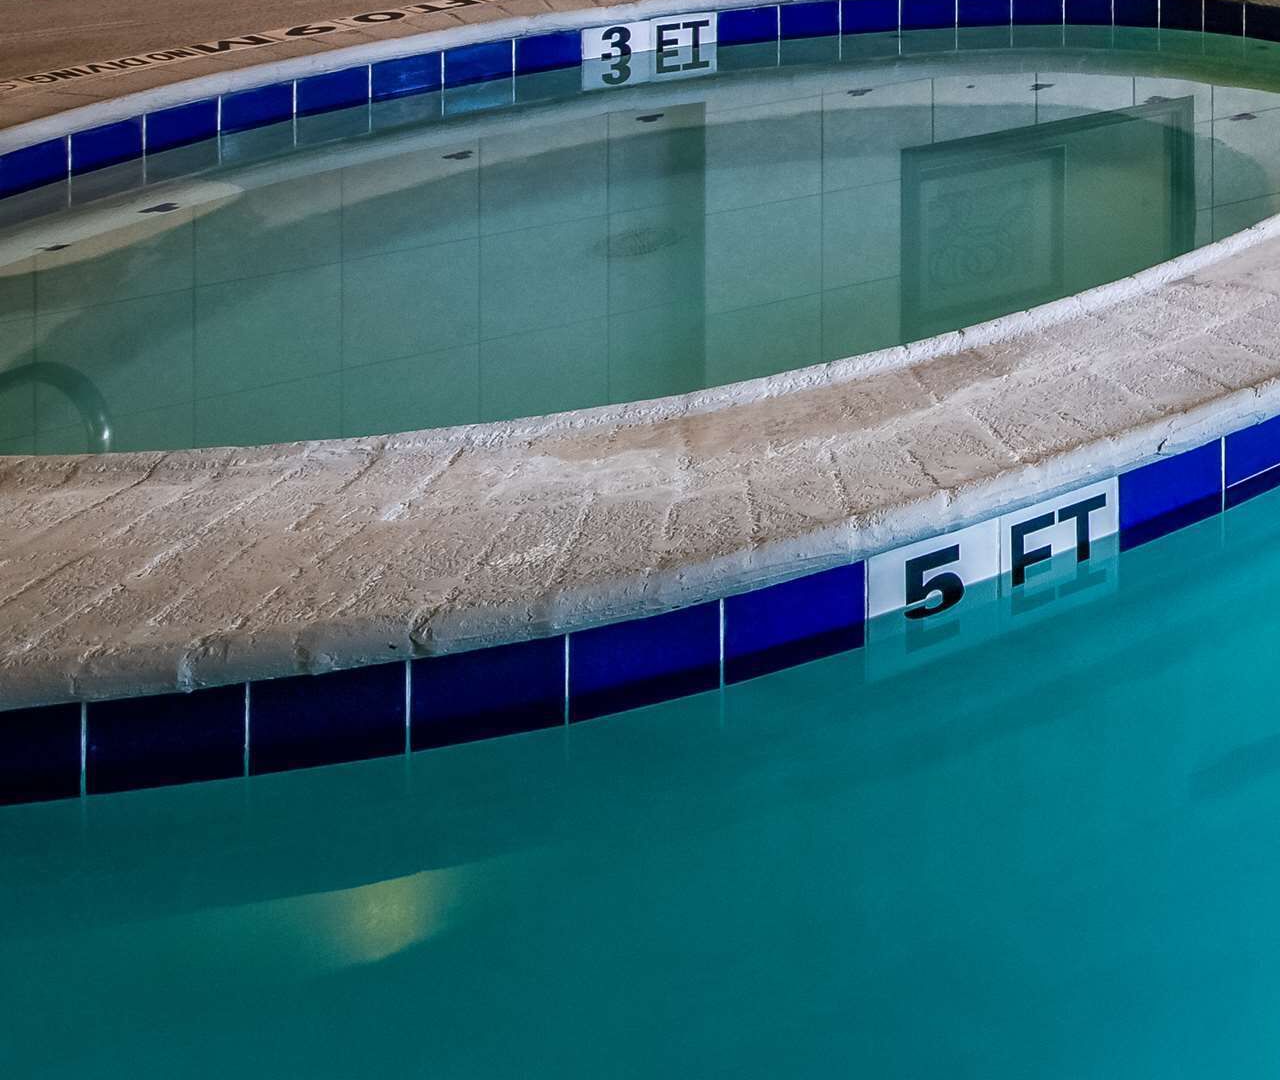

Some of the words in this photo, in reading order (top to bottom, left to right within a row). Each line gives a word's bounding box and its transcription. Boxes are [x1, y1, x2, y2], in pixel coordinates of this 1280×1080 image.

[191, 35, 274, 53] M
[601, 26, 631, 62] 3
[656, 20, 710, 57] FT
[147, 49, 196, 62] NO
[25, 57, 152, 84] DIVING
[904, 544, 965, 620] 5
[1011, 493, 1107, 589] FT
